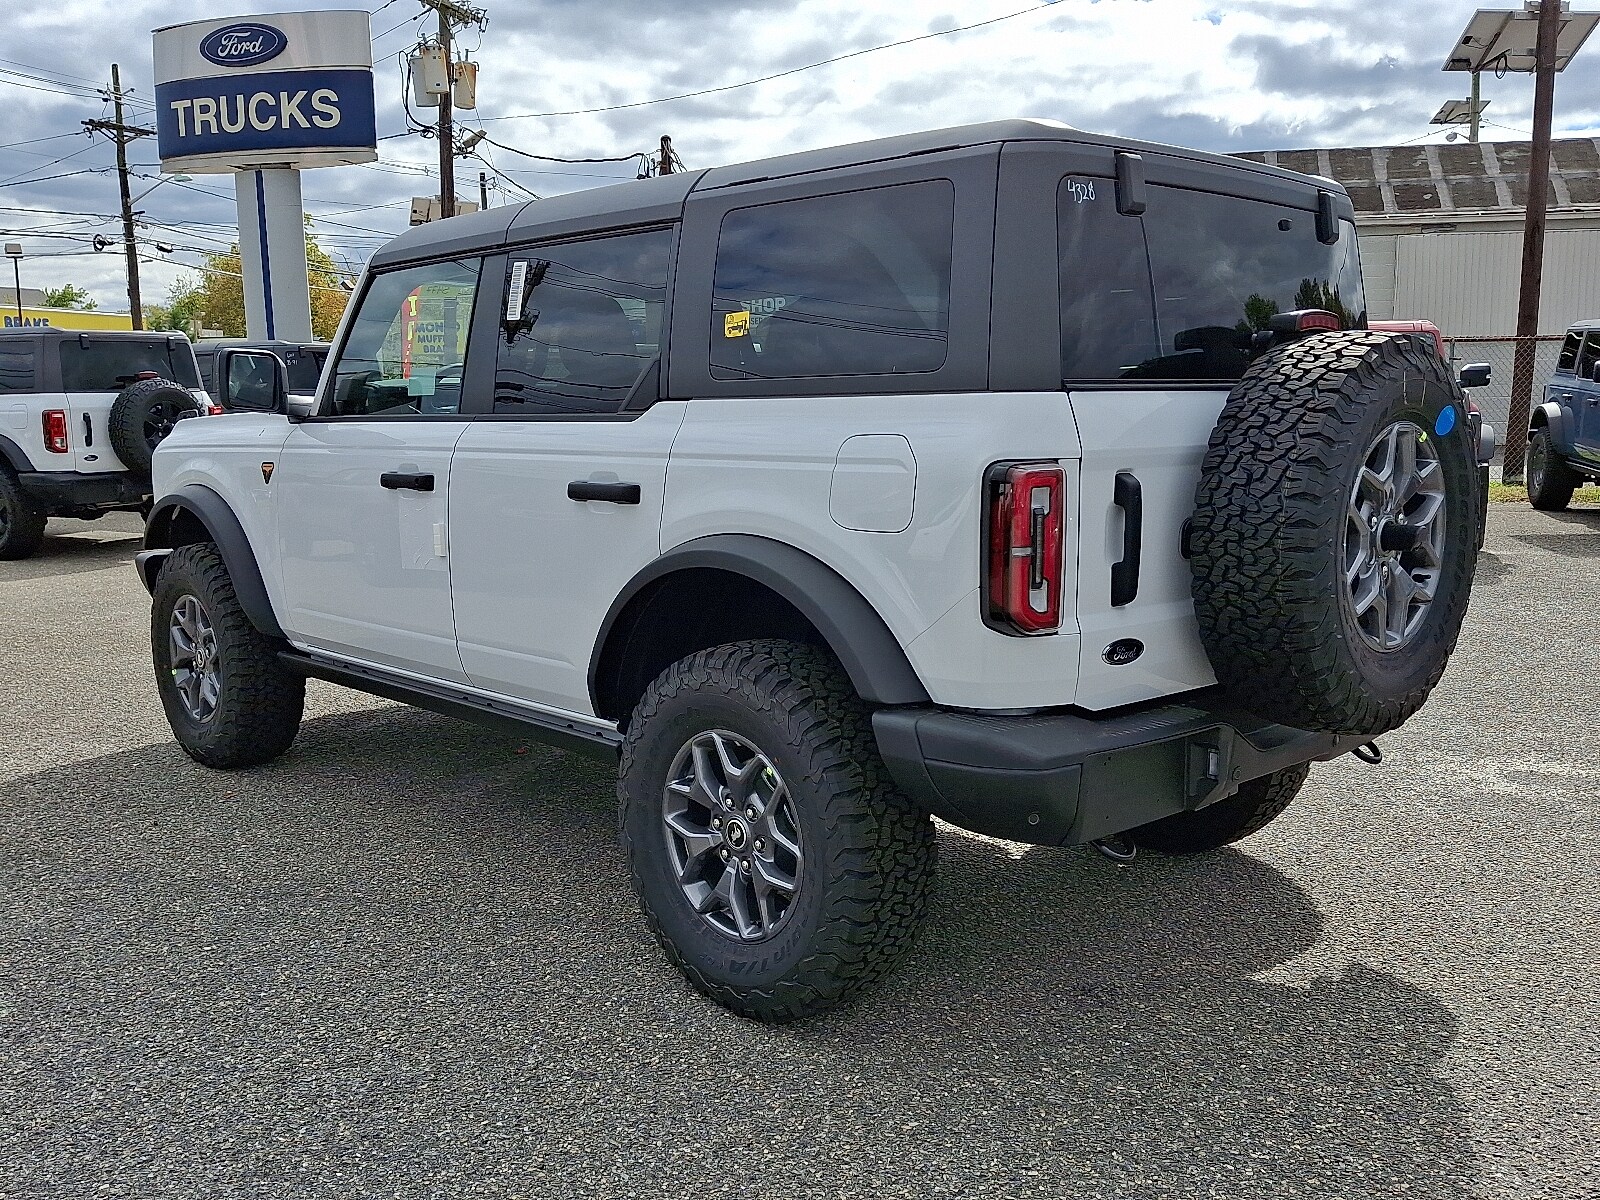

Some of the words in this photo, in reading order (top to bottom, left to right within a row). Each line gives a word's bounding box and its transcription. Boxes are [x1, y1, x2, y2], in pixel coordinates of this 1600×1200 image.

[217, 31, 264, 57] Ford
[170, 88, 342, 137] TRUCKS
[1067, 179, 1095, 203] 4328
[740, 297, 786, 313] SHOP
[4, 315, 50, 328] BRAKE
[1113, 645, 1138, 661] Ford
